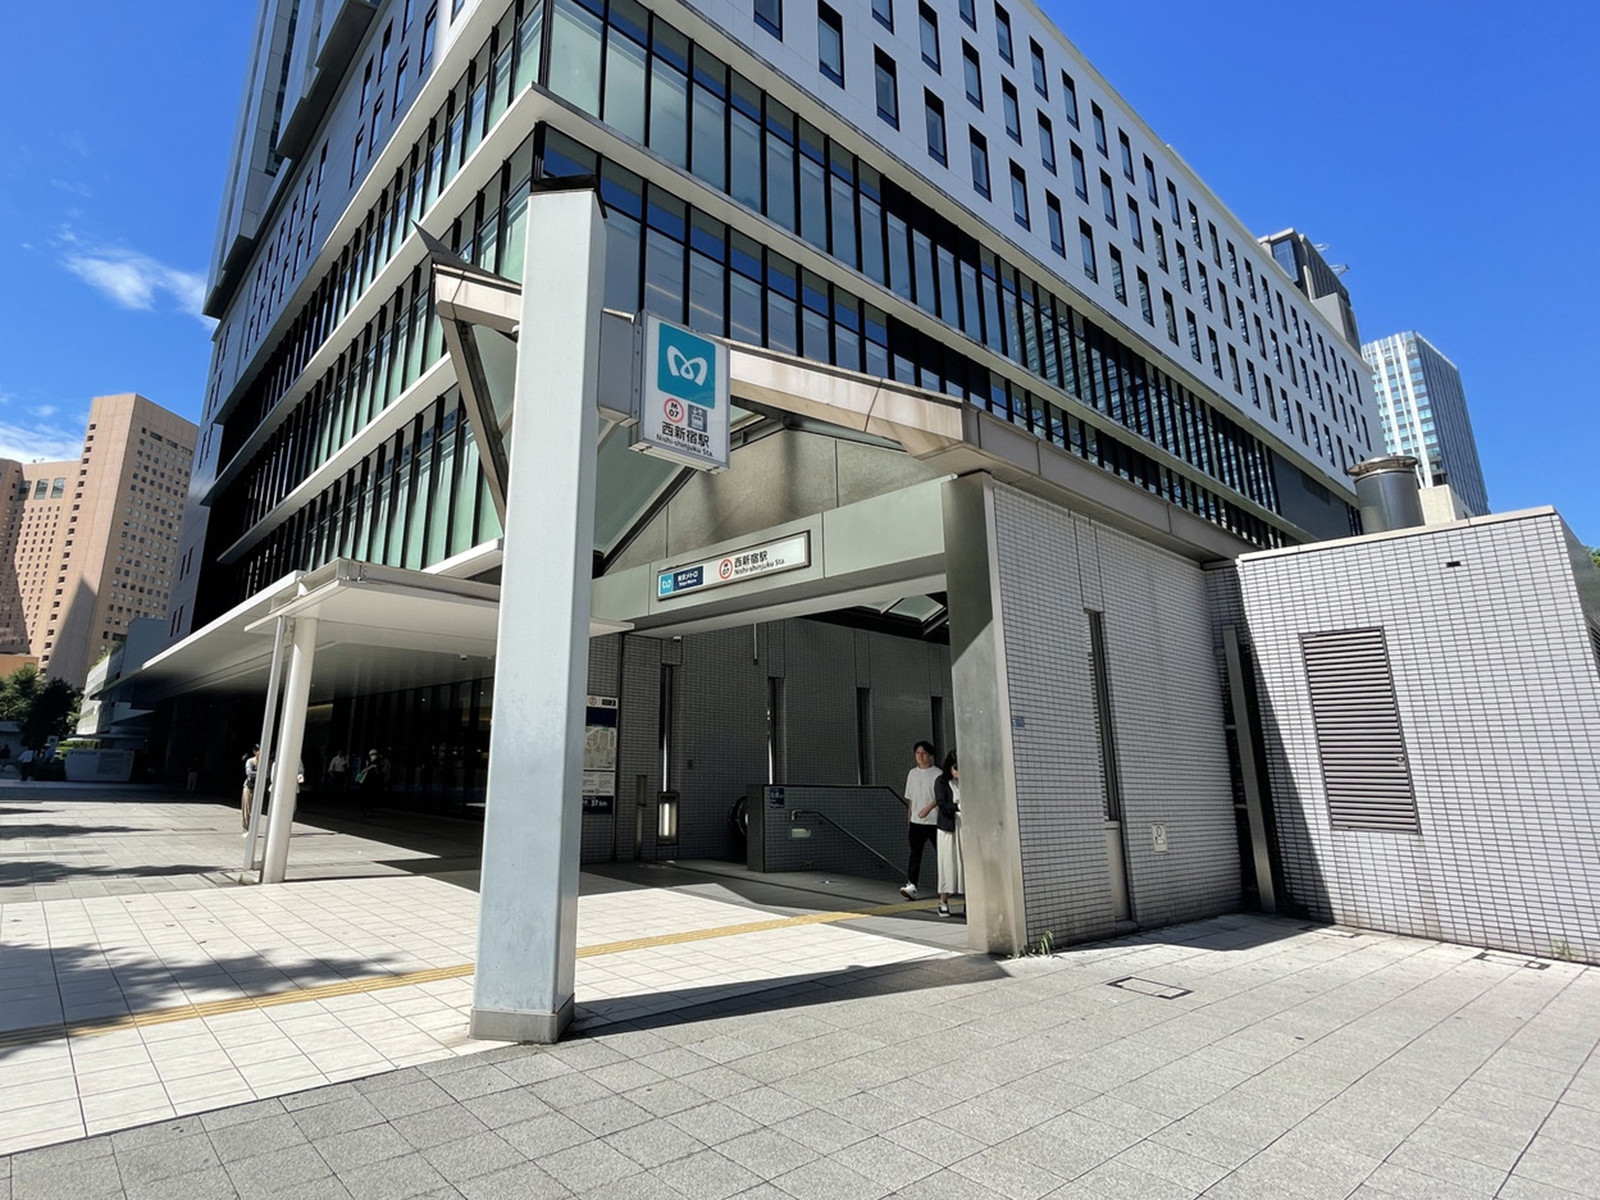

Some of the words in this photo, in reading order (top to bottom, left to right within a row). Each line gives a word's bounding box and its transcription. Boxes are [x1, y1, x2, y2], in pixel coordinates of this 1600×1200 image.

[668, 409, 680, 418] 07
[662, 421, 710, 448] 西新宿駅
[734, 550, 768, 568] 西新宿駅
[722, 567, 730, 575] 07
